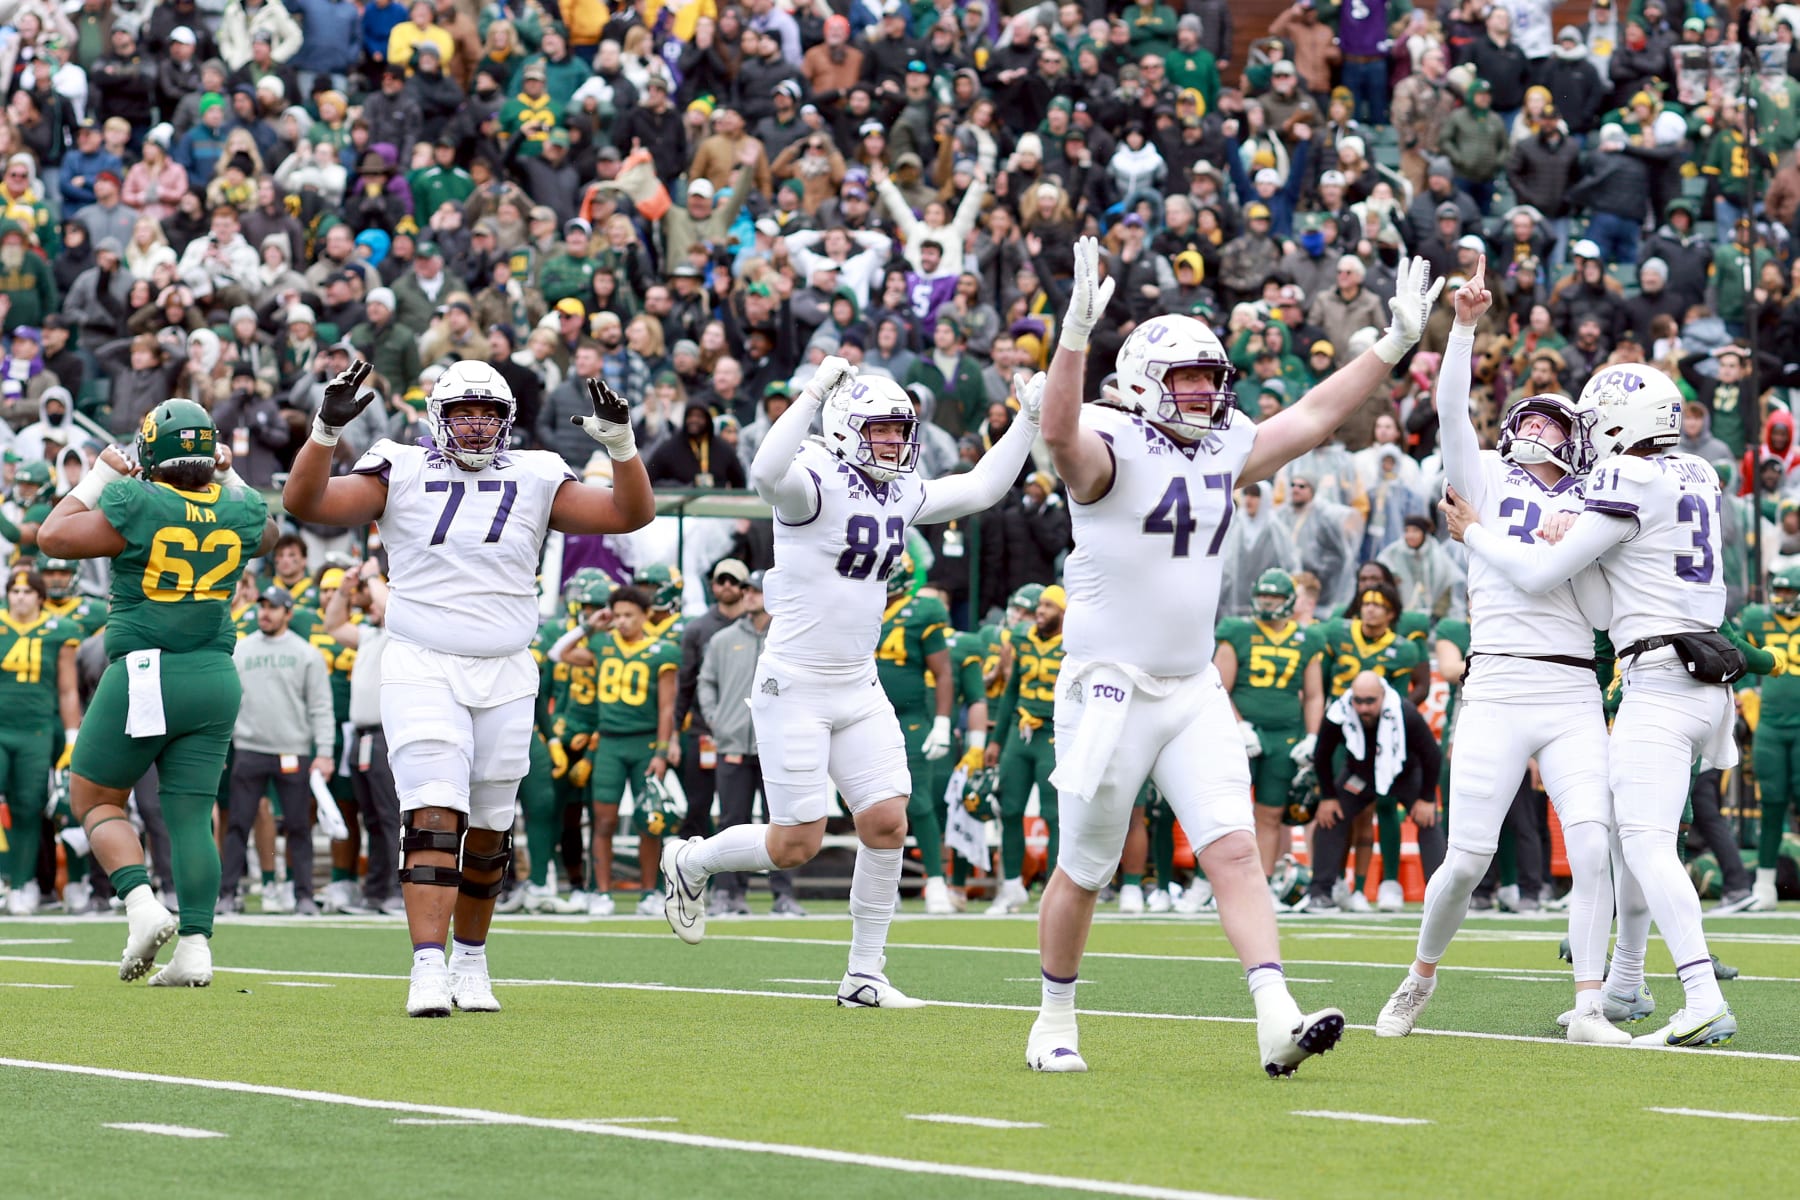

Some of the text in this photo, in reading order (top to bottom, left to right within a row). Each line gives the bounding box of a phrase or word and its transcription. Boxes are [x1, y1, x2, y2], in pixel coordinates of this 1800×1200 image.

[1593, 371, 1643, 394] TCU
[1593, 468, 1620, 491] 31
[1671, 463, 1712, 483] SANDY
[185, 501, 217, 523] IKA
[424, 480, 518, 546] 77
[1142, 471, 1233, 558] 47
[141, 526, 242, 602] 62
[835, 514, 904, 581] 82
[0, 636, 42, 683] 41
[244, 655, 297, 671] BAYLOR
[598, 657, 650, 706] 80
[1019, 655, 1064, 701] 25
[1249, 645, 1300, 688] 57
[1093, 684, 1125, 703] TCU
